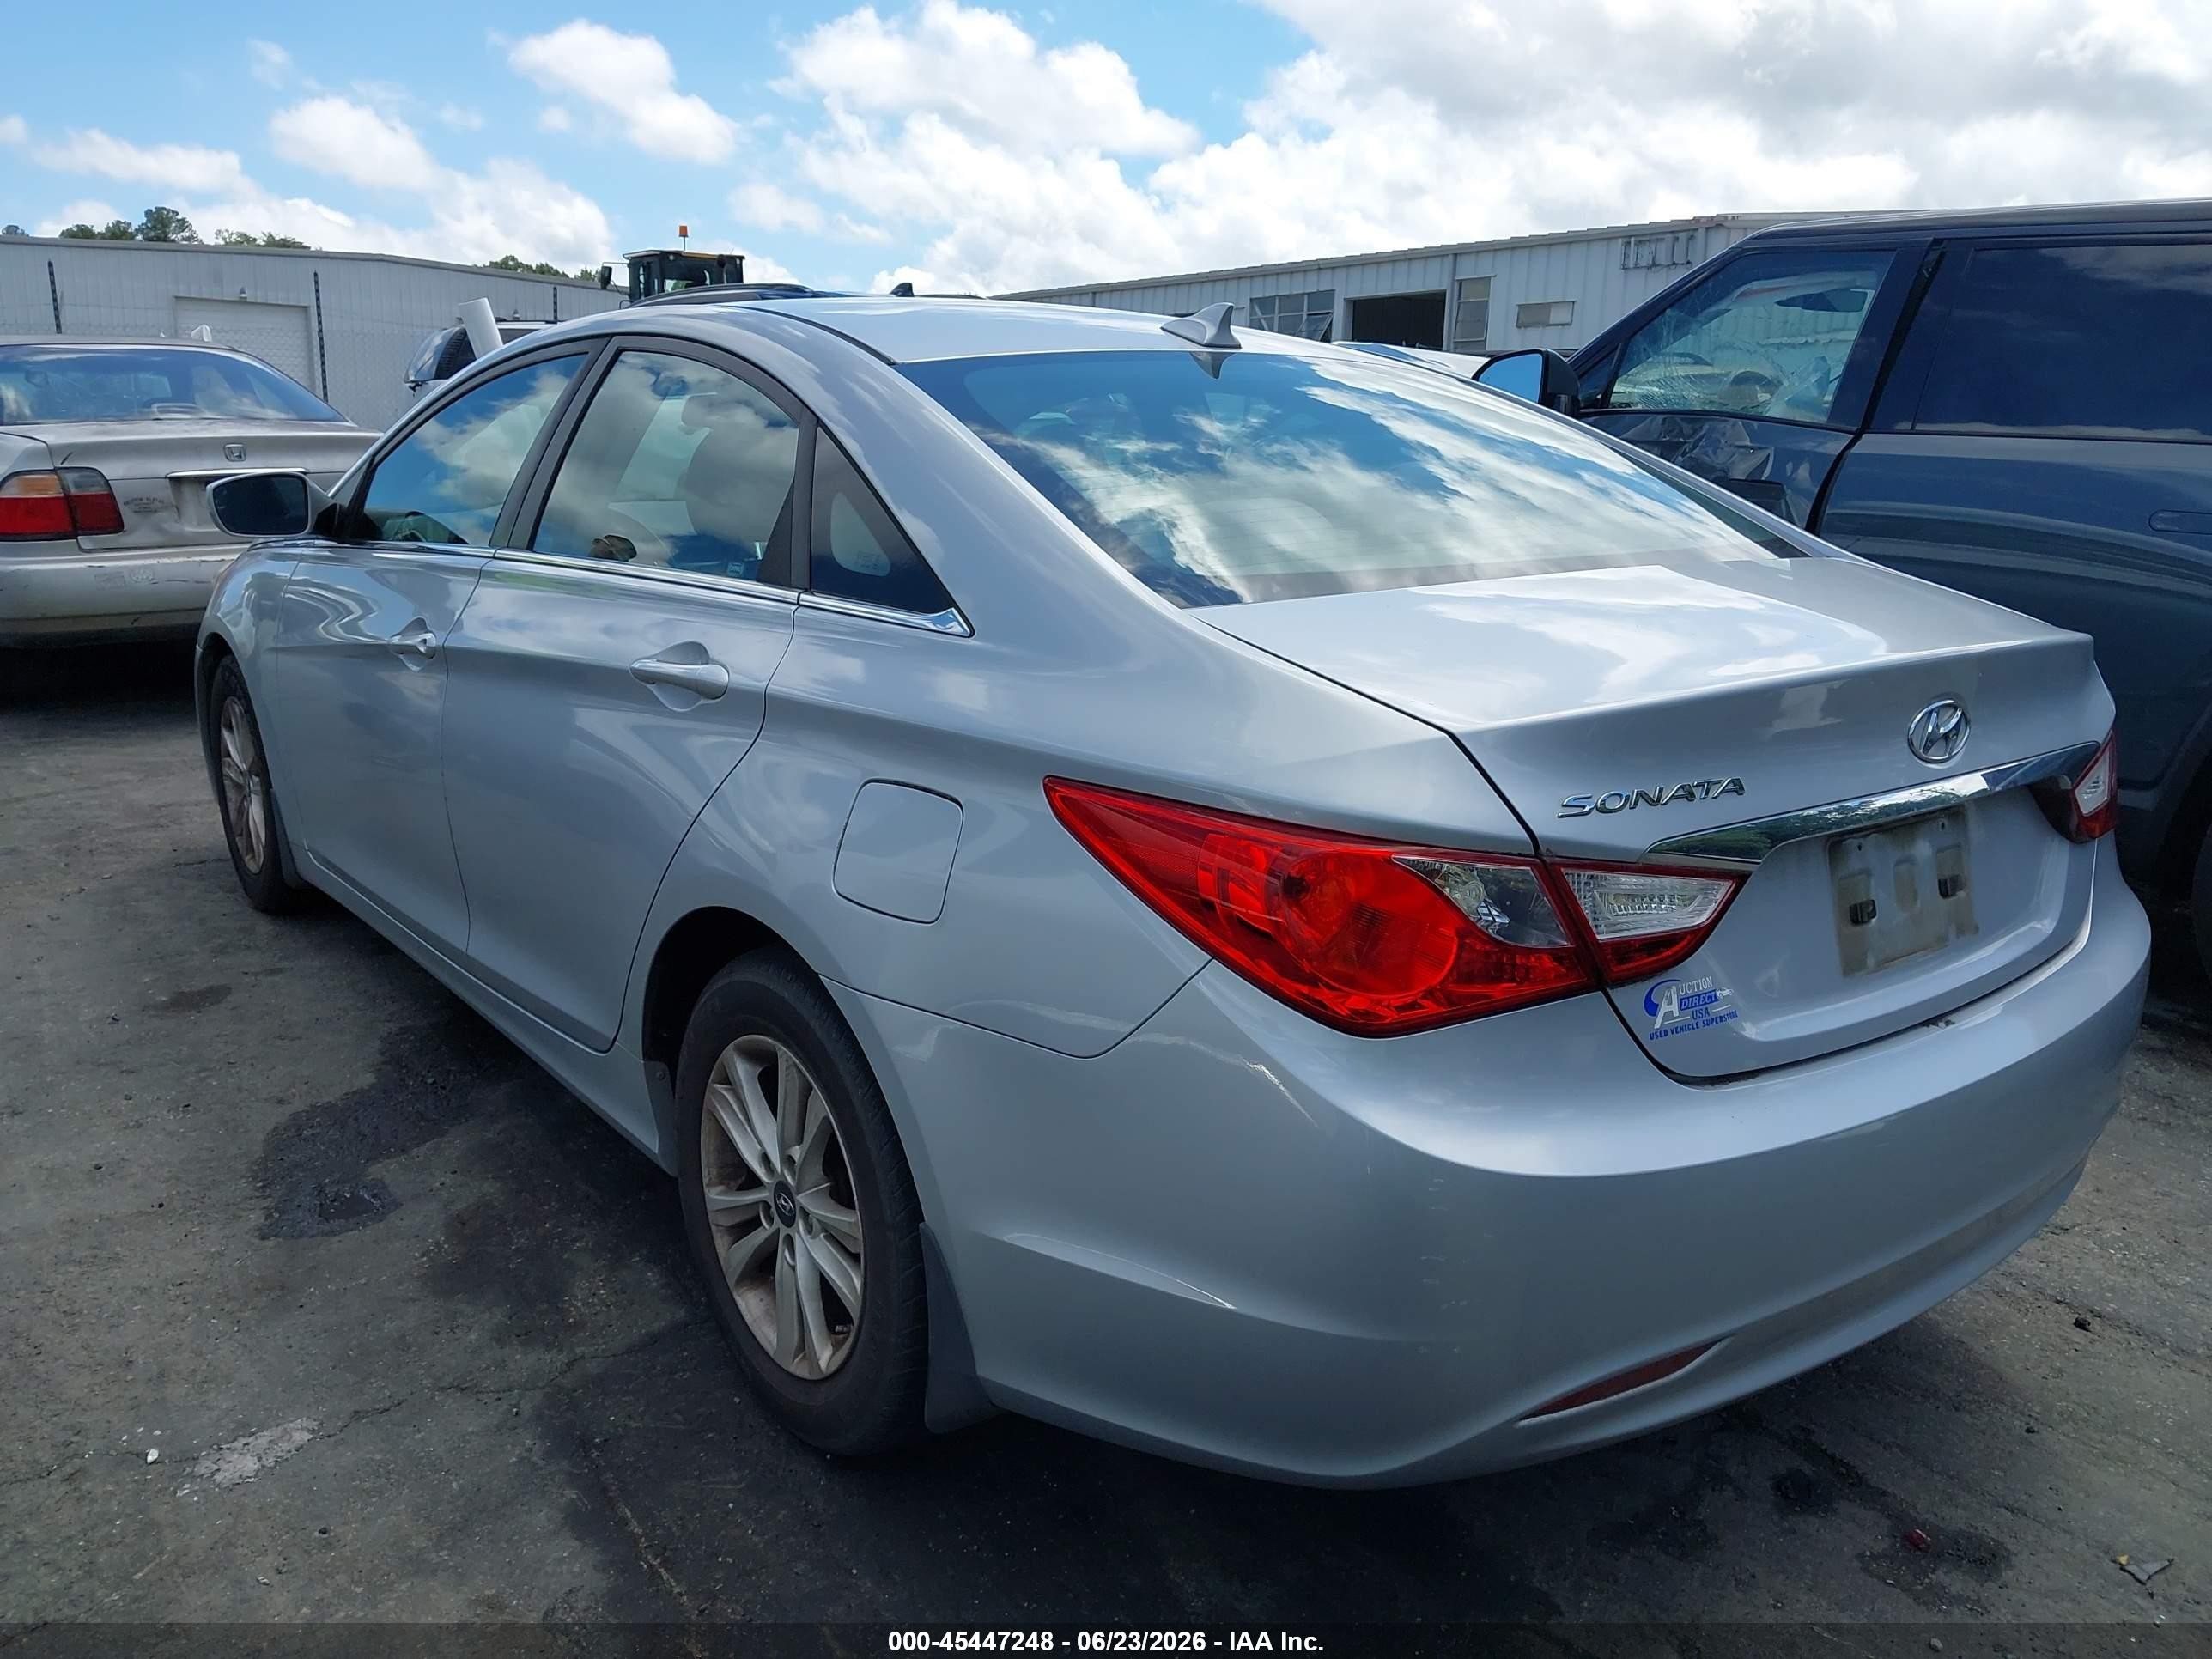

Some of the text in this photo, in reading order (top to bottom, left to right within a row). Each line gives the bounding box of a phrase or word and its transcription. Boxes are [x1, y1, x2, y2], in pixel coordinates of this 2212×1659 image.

[1557, 776, 1746, 818] SONATA
[1680, 992, 1717, 1011] DIRECT
[1692, 1007, 1711, 1020] USA
[1650, 1010, 1738, 1041] USED VEHICLE SUPERSTORE
